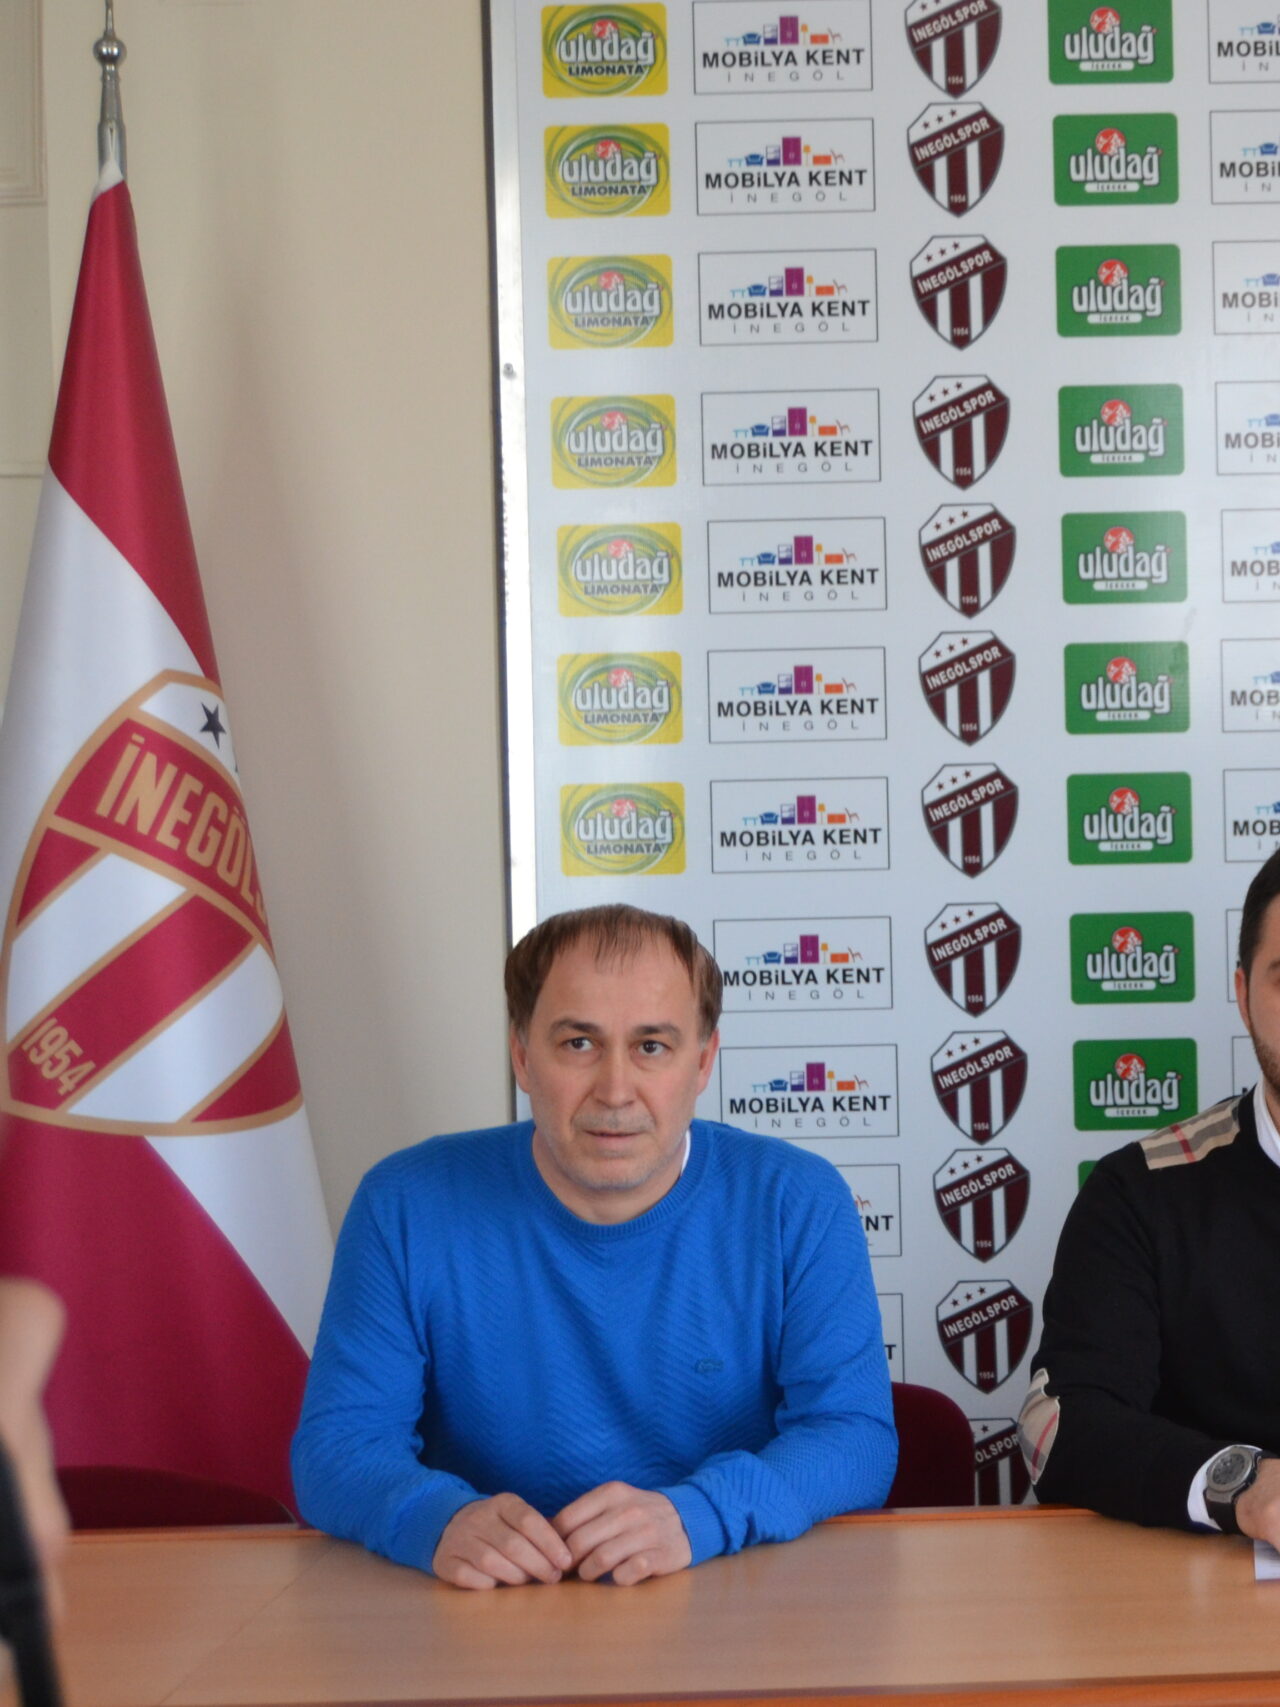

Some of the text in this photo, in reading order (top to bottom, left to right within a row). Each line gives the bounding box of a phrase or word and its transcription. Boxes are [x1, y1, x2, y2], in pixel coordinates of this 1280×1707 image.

[805, 48, 864, 67] KENT
[1065, 25, 1155, 65] uludağ
[914, 117, 990, 161] İNEGÖLSPOR
[808, 169, 867, 188] KENT
[1070, 146, 1160, 186] uludağ
[917, 250, 993, 294] İNEGÖLSPOR
[811, 300, 870, 319] KENT
[1073, 277, 1163, 317] uludağ
[920, 390, 996, 434] İNEGÖLSPOR
[814, 440, 873, 459] KENT
[1075, 417, 1165, 457] uludağ
[926, 518, 1002, 562] İNEGÖLSPOR
[820, 568, 879, 587] KENT
[1078, 544, 1168, 584] uludağ
[925, 646, 1001, 690] İNEGÖLSPOR
[820, 698, 879, 717] KENT
[1081, 675, 1171, 715] uludağ
[928, 778, 1004, 822] İNEGÖLSPOR
[823, 828, 882, 847] KENT
[1084, 805, 1174, 845] uludağ
[931, 917, 1007, 961] İNEGÖLSPOR
[826, 967, 885, 986] KENT
[1087, 944, 1177, 984] uludağ
[22, 1017, 96, 1096] 1954
[937, 1045, 1013, 1089] İNEGÖLSPOR
[832, 1094, 891, 1113] KENT
[1090, 1071, 1180, 1111] uludağ
[940, 1163, 1016, 1207] İNEGÖLSPOR
[943, 1294, 1019, 1338] İNEGÖLSPOR
